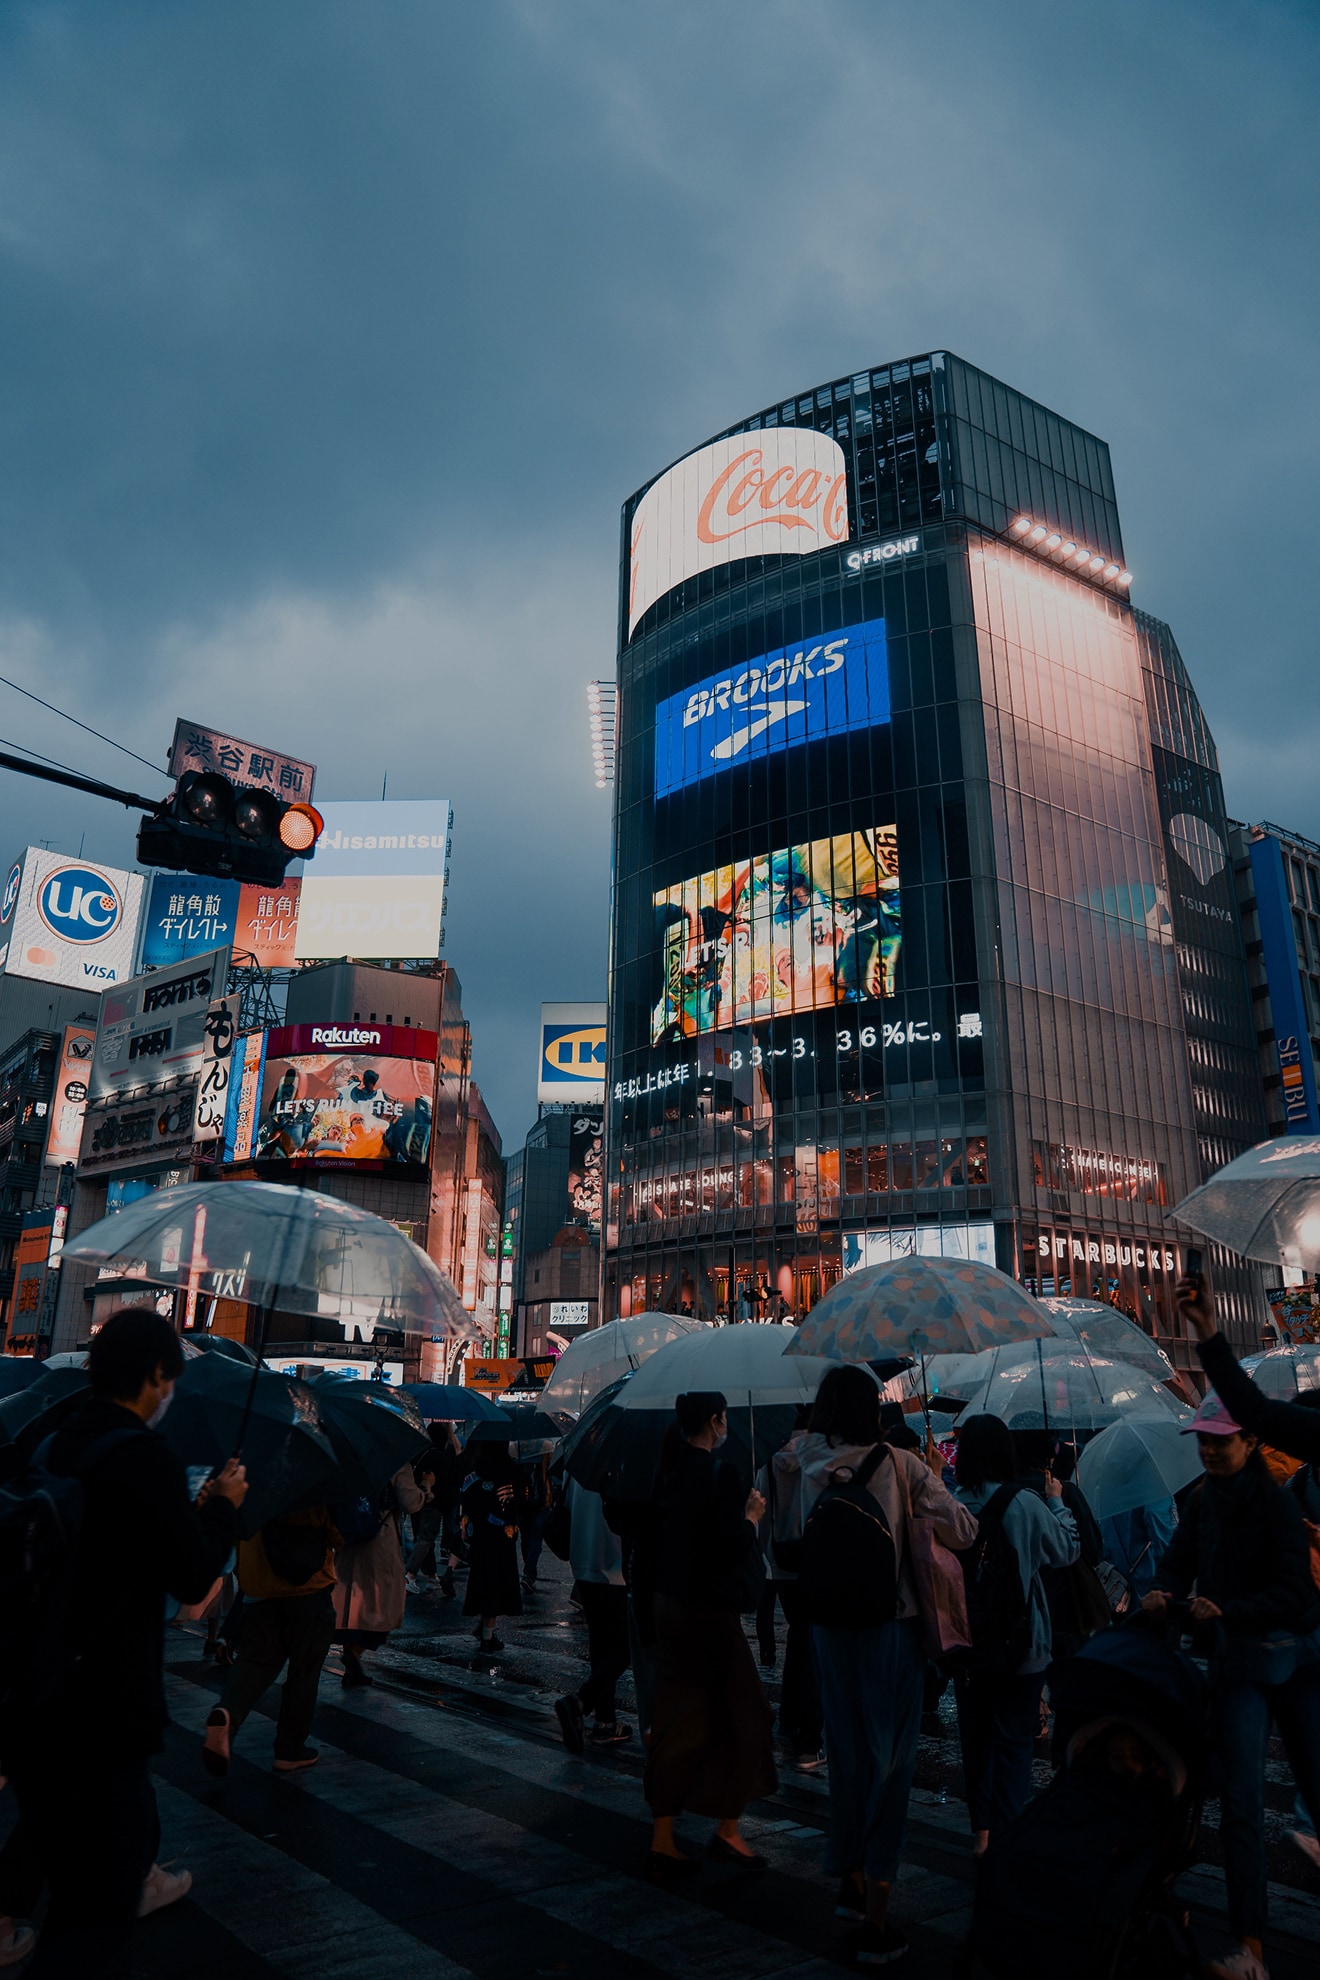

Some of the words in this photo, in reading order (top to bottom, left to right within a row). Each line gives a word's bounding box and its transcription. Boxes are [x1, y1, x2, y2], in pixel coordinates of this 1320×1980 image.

[847, 537, 919, 570] QFRONT
[683, 638, 849, 728] BROOKS
[185, 732, 304, 792] 渋谷駅前
[168, 894, 221, 916] 龍角散
[309, 902, 431, 933] サロンパス
[1180, 894, 1233, 924] TSUTAYA
[158, 918, 228, 940] ダイレクト
[83, 963, 116, 981] VISA
[312, 1027, 381, 1045] Rakuten
[957, 1012, 983, 1038] 最
[198, 1000, 235, 1135] もんじゃ
[1278, 1036, 1308, 1121] SEIBU
[276, 1099, 316, 1114] LET'S
[315, 1159, 338, 1167] Rakuten
[339, 1160, 356, 1168] Vision
[1038, 1235, 1175, 1272] STARBUCKS
[552, 1315, 587, 1323] クリニック
[561, 1305, 588, 1313] れいわ
